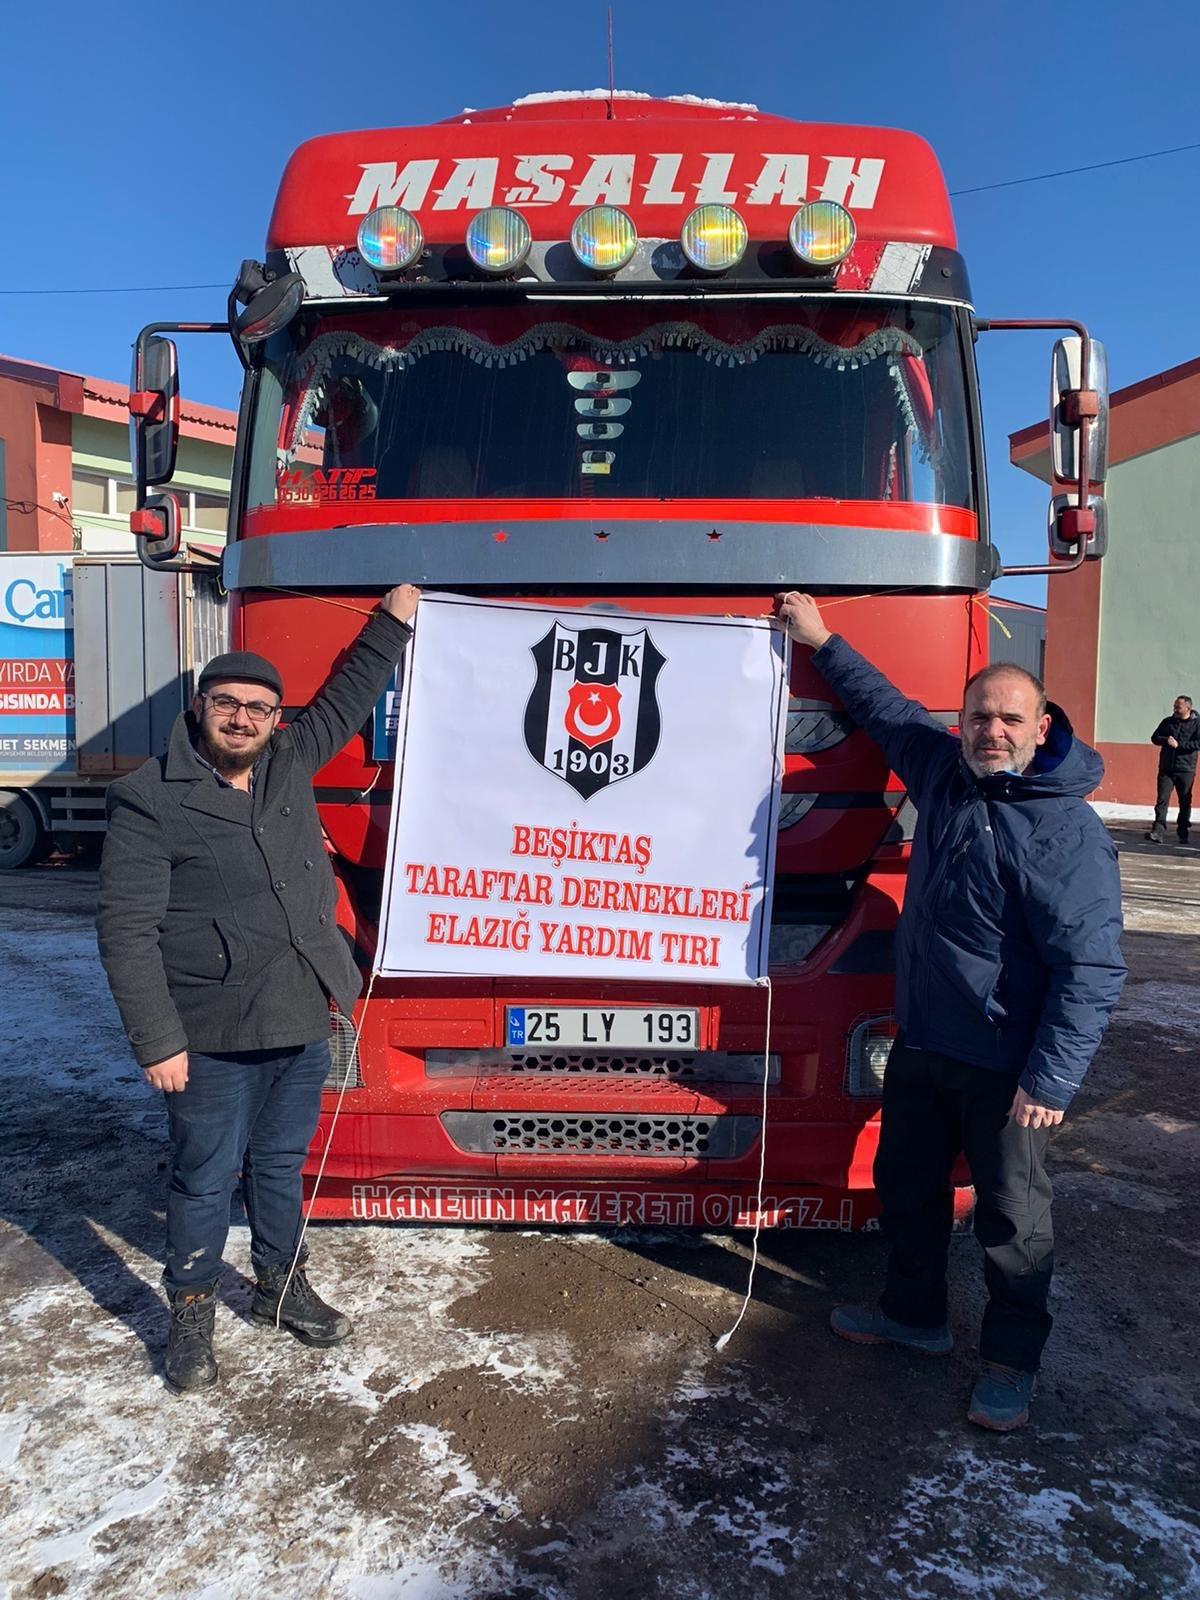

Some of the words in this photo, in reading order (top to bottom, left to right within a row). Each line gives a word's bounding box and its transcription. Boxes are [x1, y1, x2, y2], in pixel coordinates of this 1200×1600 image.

[554, 638, 641, 678] BJK
[0, 739, 18, 751] ET
[553, 749, 629, 776] 1903
[512, 820, 652, 874] BEŞİKTAŞ
[405, 863, 552, 906] TARAFTAR
[560, 876, 752, 922] DERNEKLERİ
[426, 911, 531, 952] ELAZIĞ
[539, 921, 654, 962] YARDIM
[661, 931, 720, 968] TIRI
[511, 1030, 524, 1039] TR
[527, 1013, 560, 1041] 25
[582, 1013, 615, 1042] LY
[643, 1013, 691, 1043] 193
